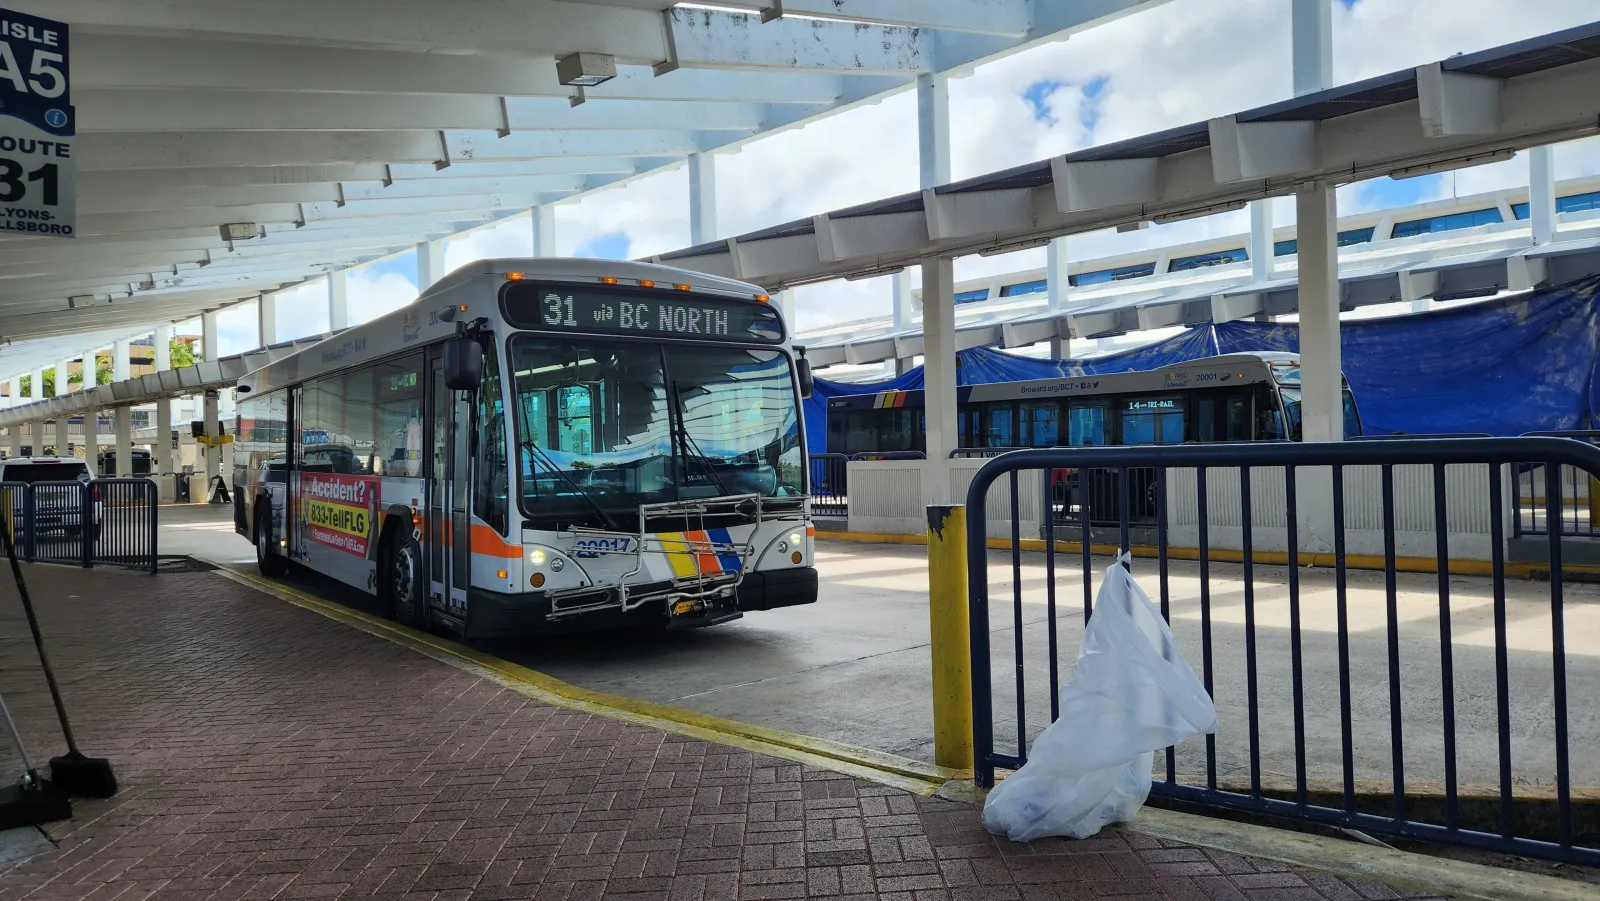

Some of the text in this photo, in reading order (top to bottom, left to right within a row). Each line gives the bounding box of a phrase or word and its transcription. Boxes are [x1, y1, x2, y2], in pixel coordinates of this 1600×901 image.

[0, 19, 58, 47] ISLE
[543, 293, 728, 336] 31 via BC NORTH
[1021, 382, 1075, 394] Broward.org/BCT
[1196, 373, 1217, 381] 20001
[1128, 401, 1140, 410] 14
[1147, 400, 1175, 408] TRI-RAIL
[311, 476, 366, 503] Accident?
[311, 504, 365, 534] 833-TellFLG
